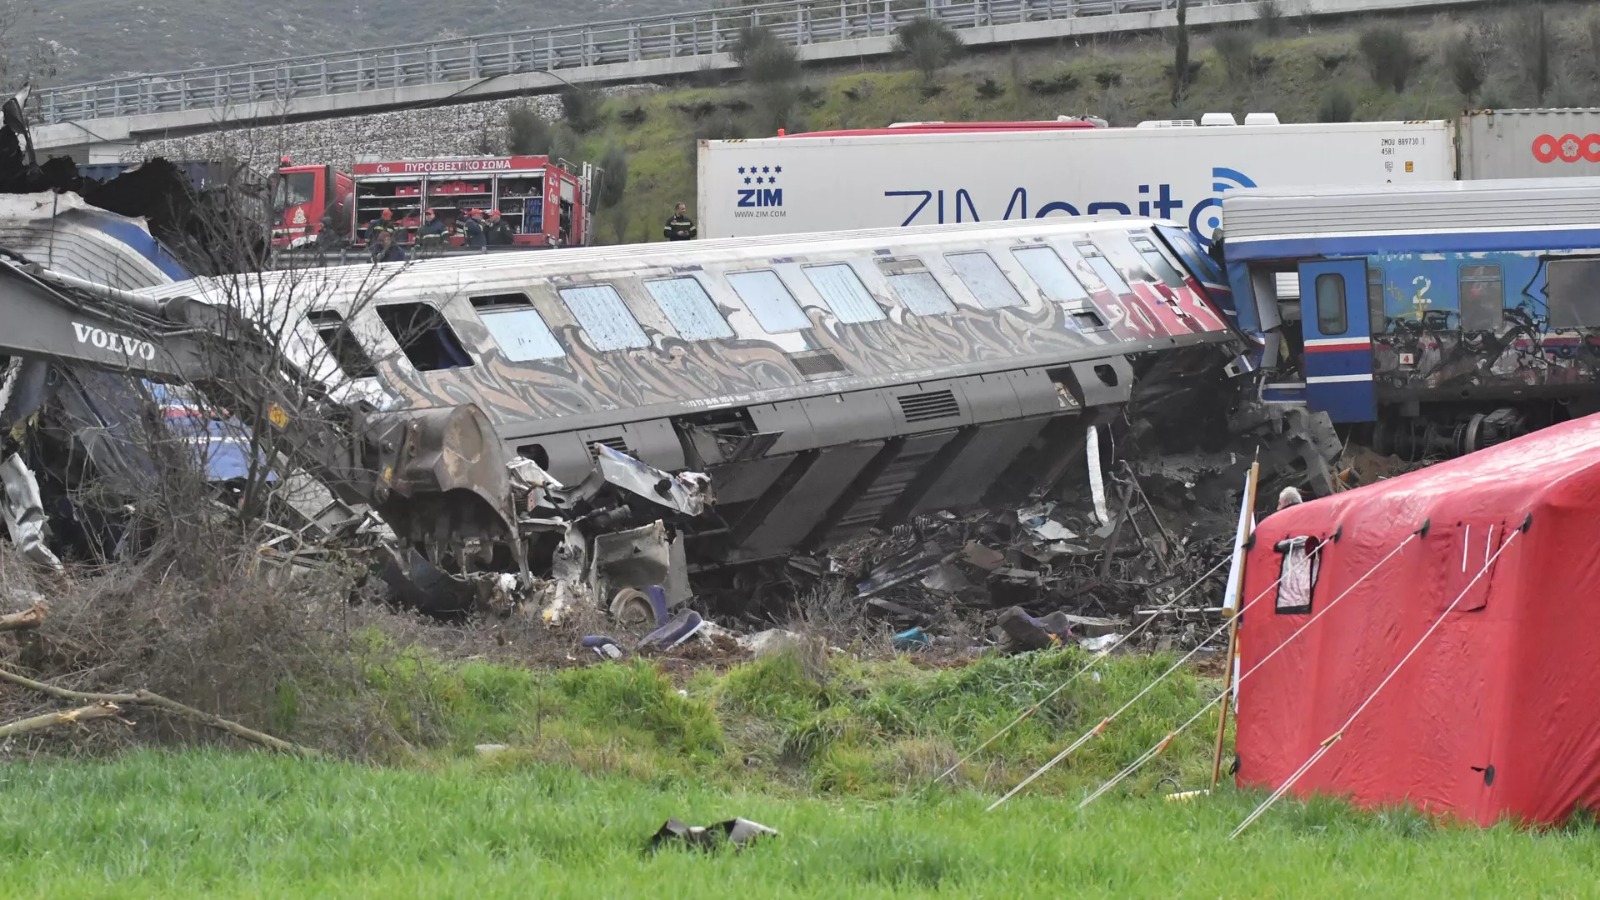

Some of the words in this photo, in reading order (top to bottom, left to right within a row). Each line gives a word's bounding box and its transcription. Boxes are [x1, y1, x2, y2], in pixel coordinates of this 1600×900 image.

[1381, 138, 1395, 146] ZMOU
[1398, 137, 1419, 145] 889730
[1381, 147, 1394, 155] 45R1
[482, 160, 511, 170] ΣΩΜΑ
[737, 188, 783, 207] ZIM
[734, 210, 787, 218] WWW.ZIM.COM
[1412, 275, 1432, 304] 2
[71, 321, 155, 361] VOLVO
[1403, 354, 1410, 363] 4
